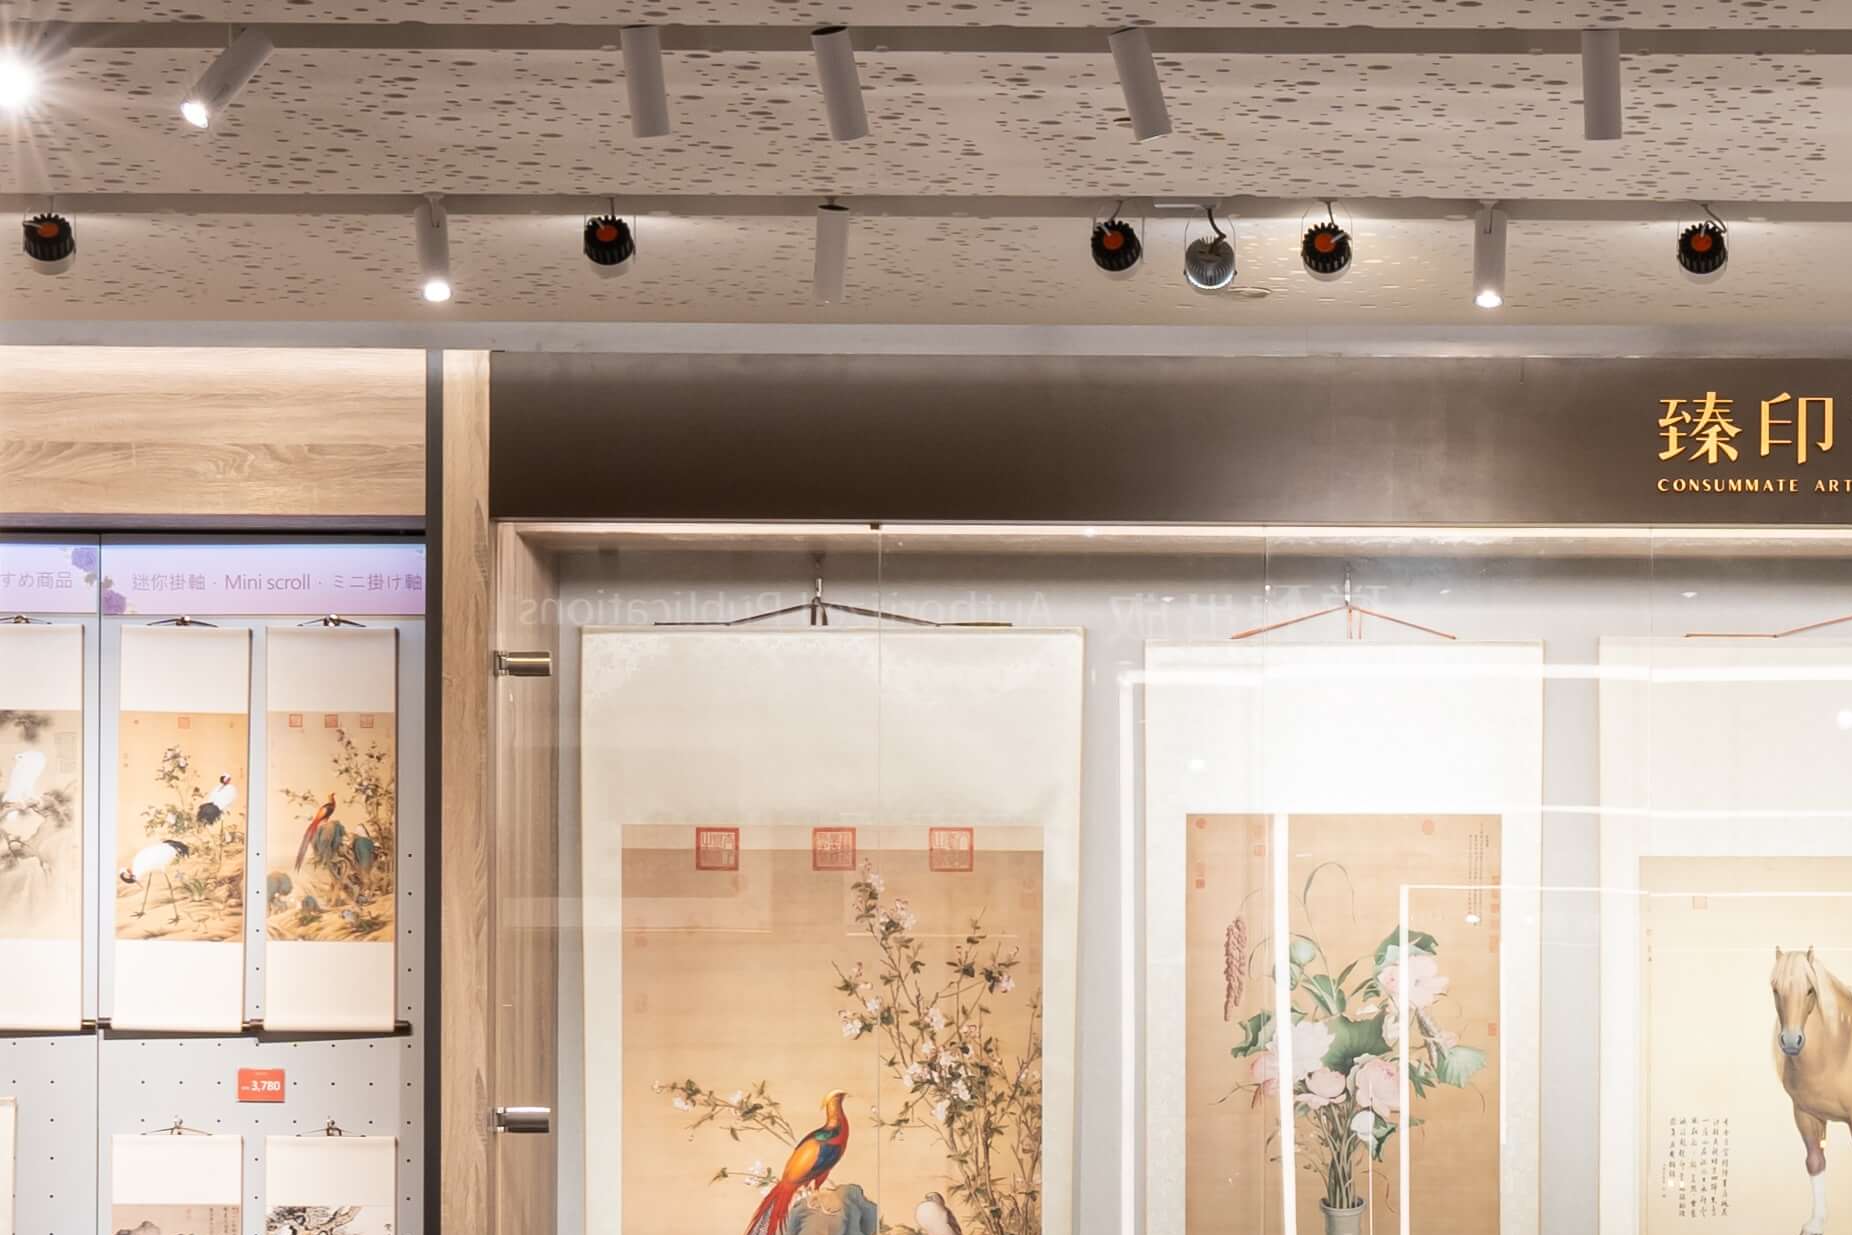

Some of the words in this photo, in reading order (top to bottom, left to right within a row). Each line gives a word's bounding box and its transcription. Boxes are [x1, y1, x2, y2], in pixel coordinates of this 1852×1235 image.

[1657, 478, 1800, 494] CONSUMMATE
[132, 573, 207, 592] 迷你掛軸
[224, 573, 263, 591] Mini
[267, 573, 312, 591] scroll
[251, 1080, 281, 1092] 3,780
